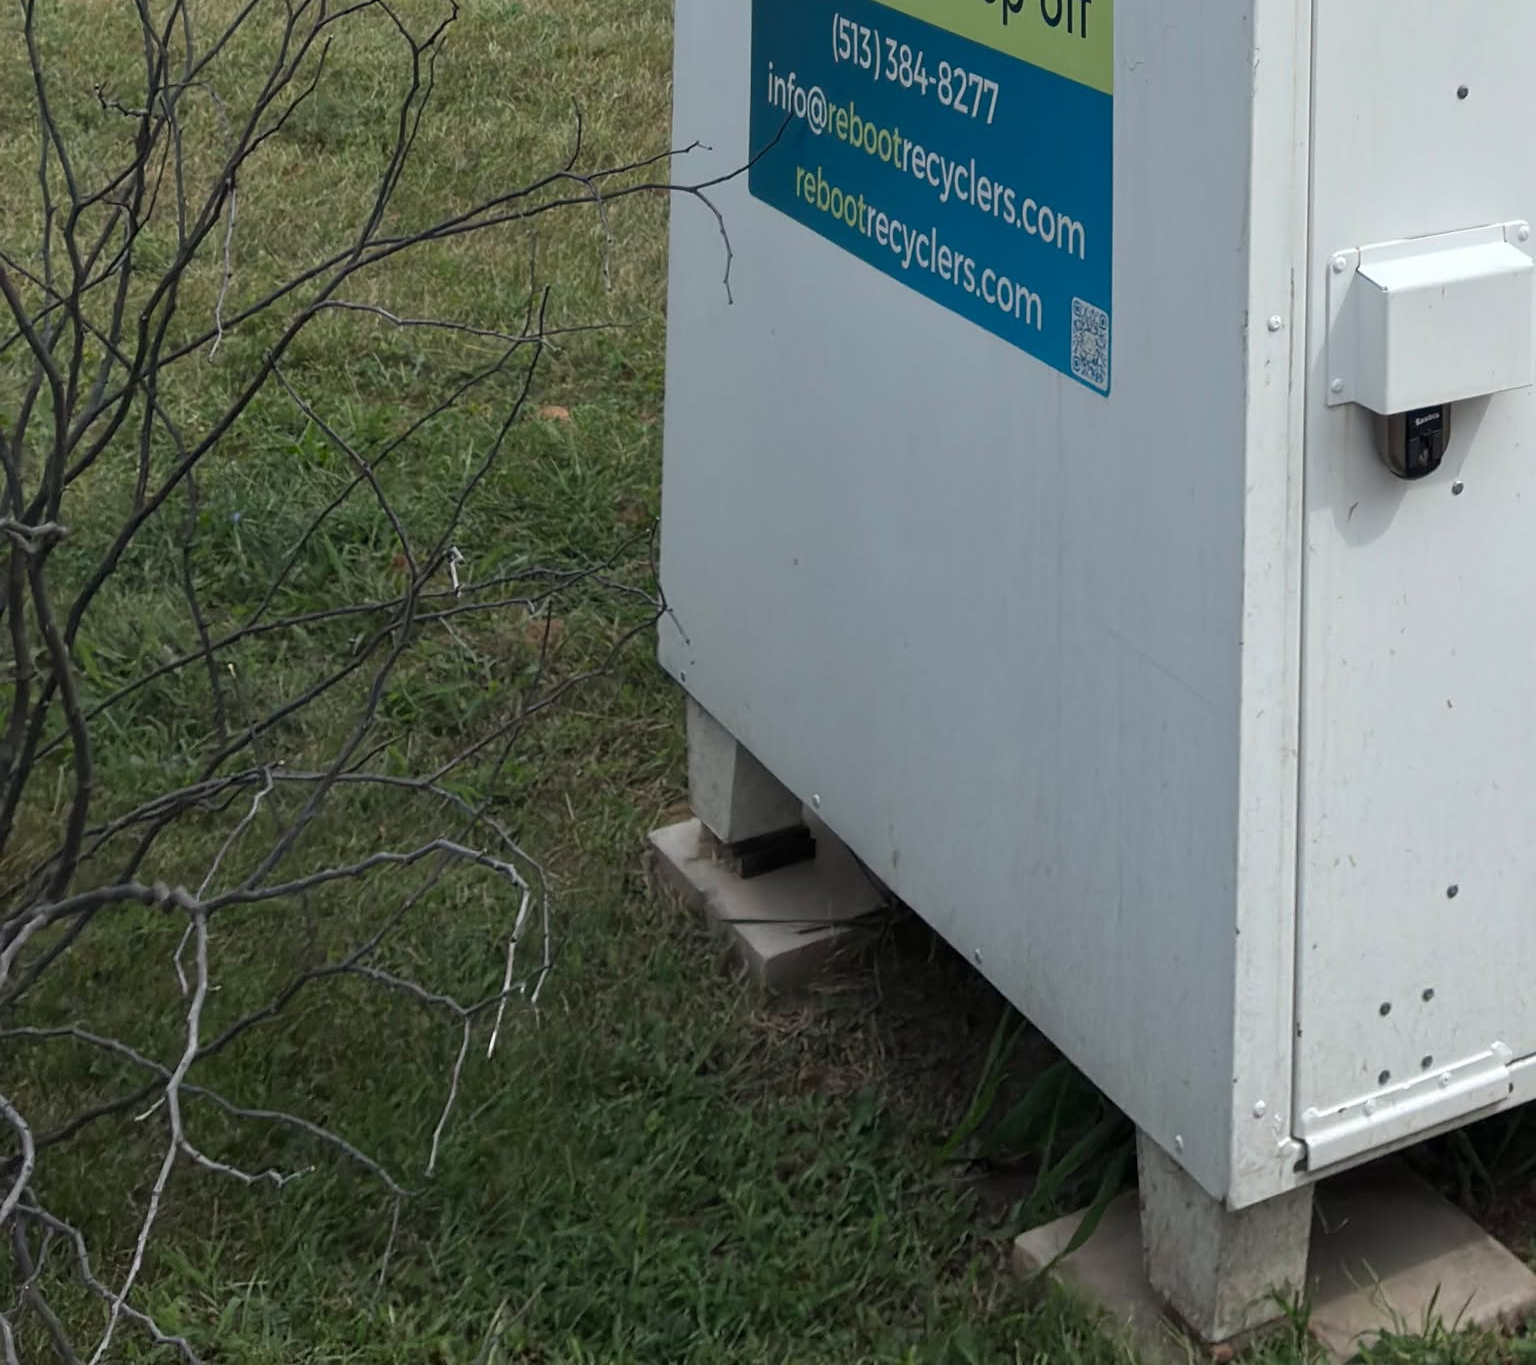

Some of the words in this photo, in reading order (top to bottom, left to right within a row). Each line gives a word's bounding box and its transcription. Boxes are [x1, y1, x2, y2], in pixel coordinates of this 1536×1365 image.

[832, 12, 883, 81] (513)
[884, 37, 1000, 126] 384-8277
[767, 60, 1086, 261] info@rebootrecyclers.com
[796, 159, 1042, 332] rebootrecyclers.com
